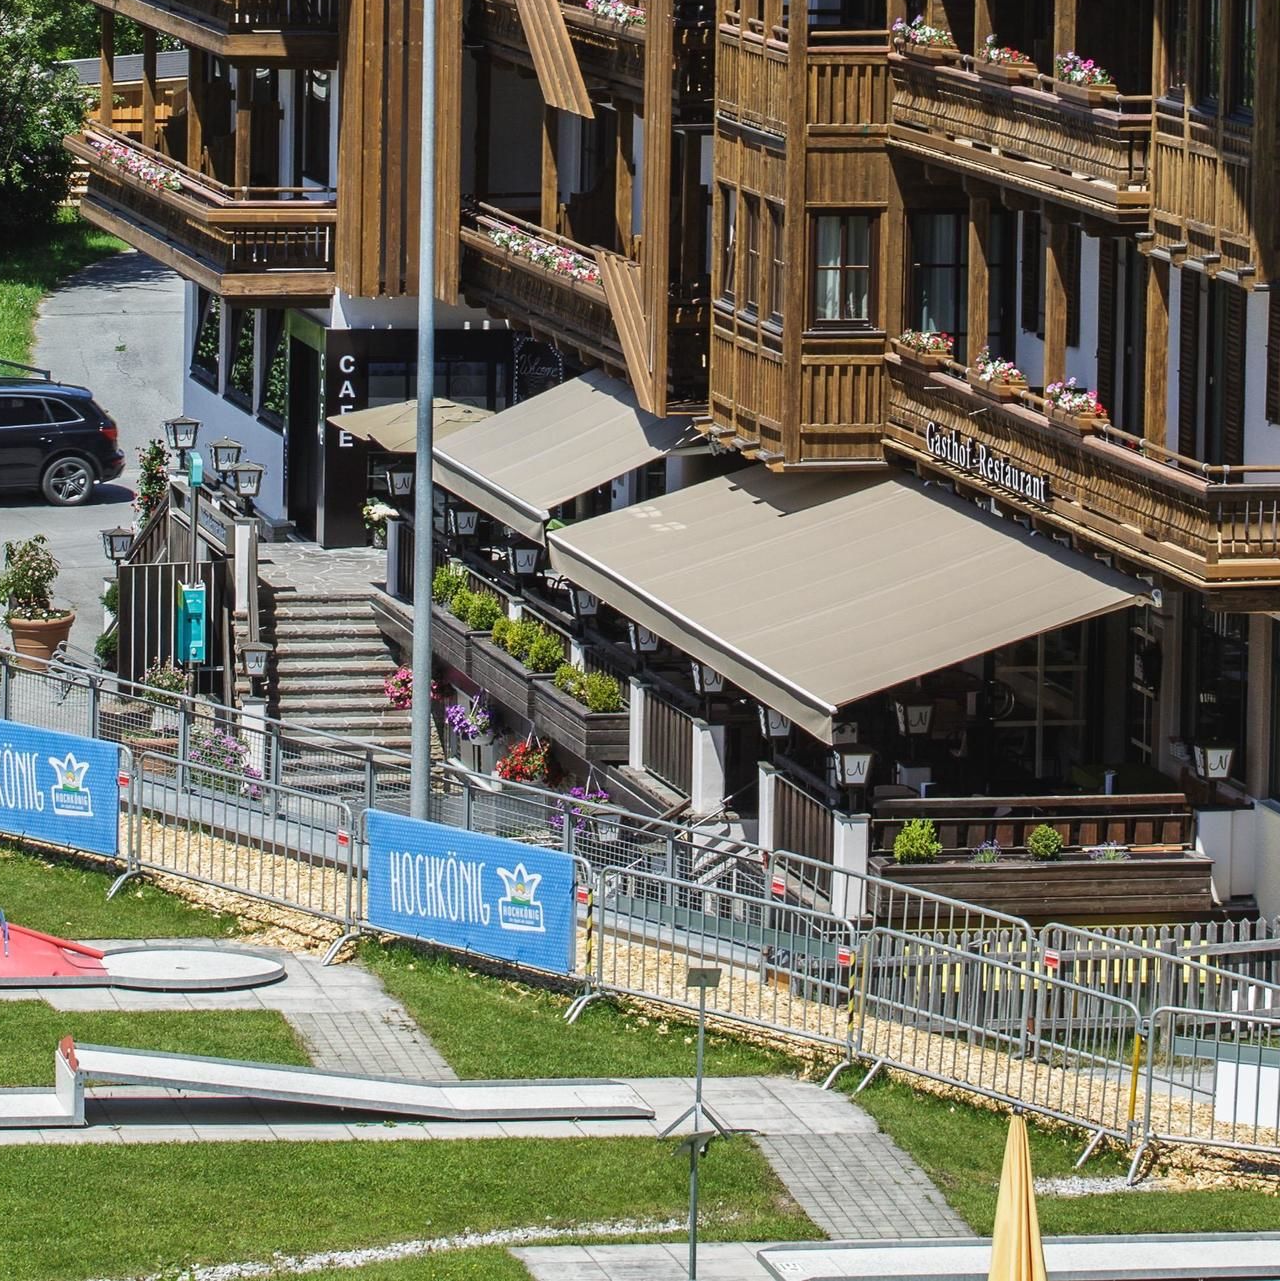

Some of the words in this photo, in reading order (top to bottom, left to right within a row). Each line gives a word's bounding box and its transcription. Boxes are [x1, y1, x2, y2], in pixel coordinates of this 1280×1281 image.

[926, 421, 972, 469] Gasthof
[978, 444, 1046, 503] Restaurant
[390, 850, 491, 926] HOCHKÖNIG
